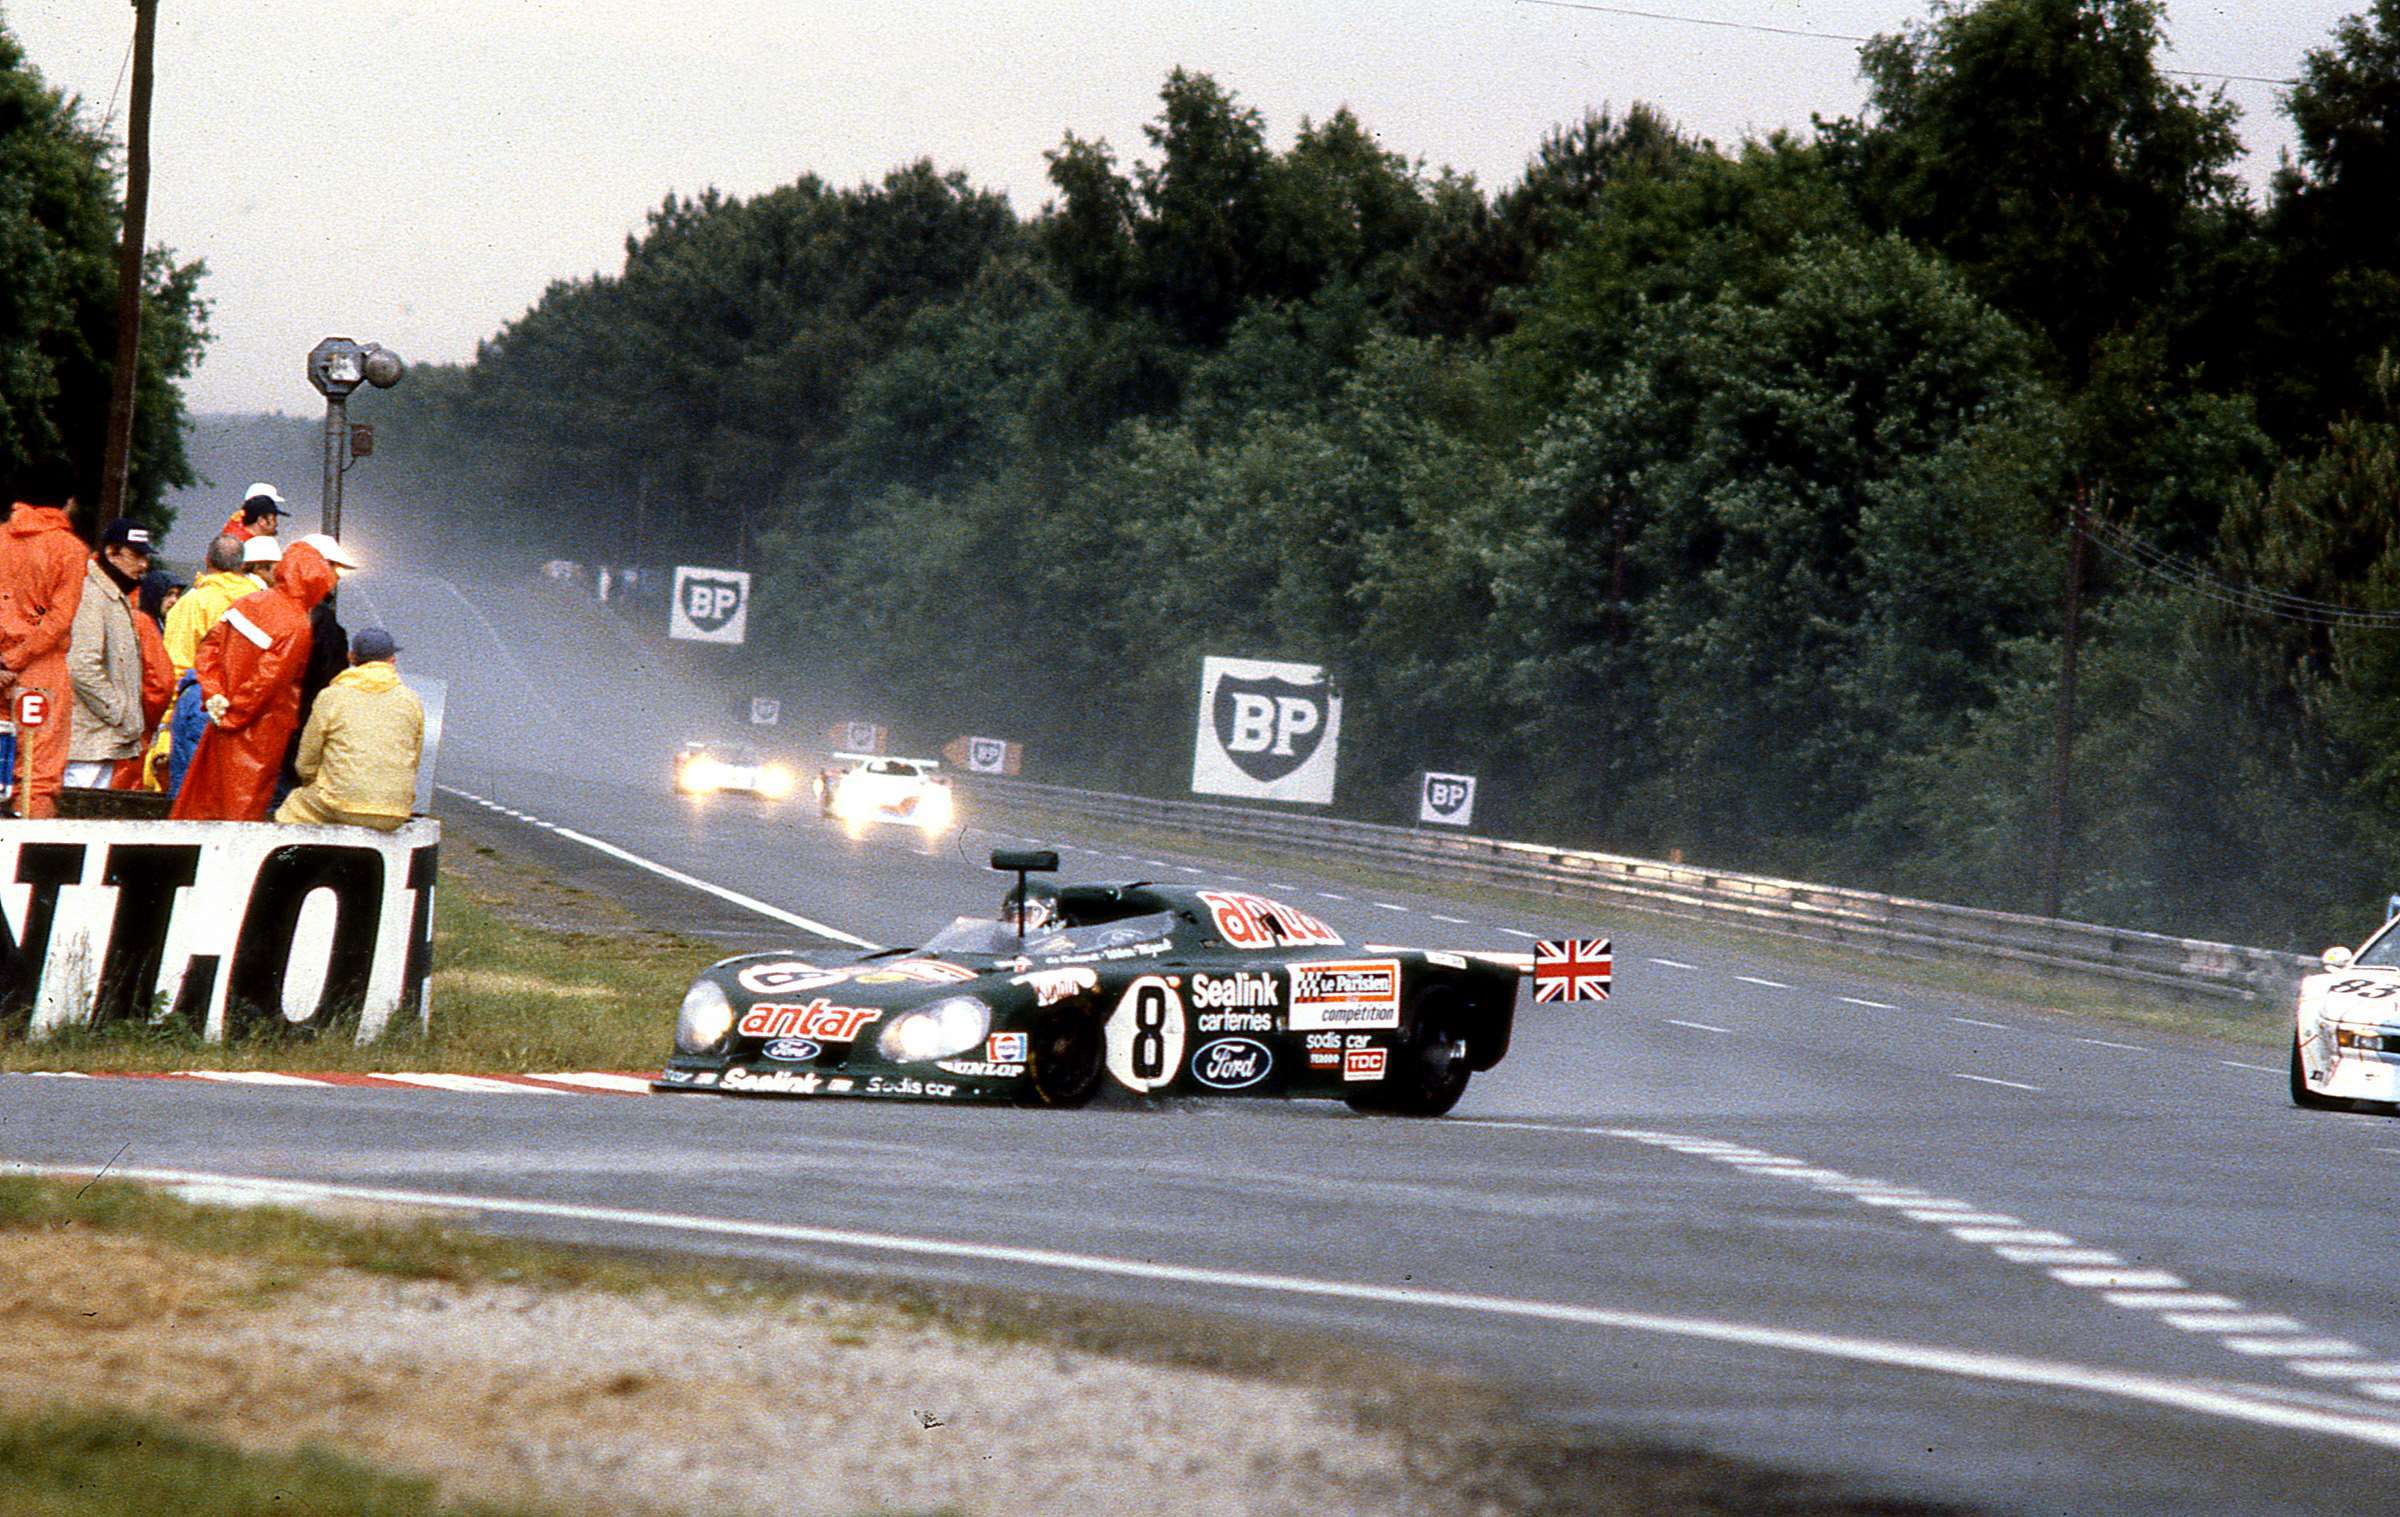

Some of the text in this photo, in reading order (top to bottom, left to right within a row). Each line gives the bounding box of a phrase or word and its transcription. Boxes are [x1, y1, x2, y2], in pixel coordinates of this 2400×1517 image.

[689, 585, 737, 619] BP
[22, 695, 44, 724] E
[1227, 692, 1319, 757] BP
[1431, 783, 1465, 807] BP
[1192, 972, 1279, 1008] Sealink
[1336, 974, 1390, 992] Parisien
[740, 1000, 882, 1040] antar
[1132, 986, 1166, 1079] 8
[770, 1040, 812, 1058] Ford
[1346, 1034, 1372, 1048] car
[954, 1060, 1026, 1077] DUNLOP
[1206, 1044, 1258, 1078] Ford
[1349, 1054, 1382, 1069] TDC
[720, 1067, 824, 1094] Sealink
[924, 1082, 957, 1097] car
